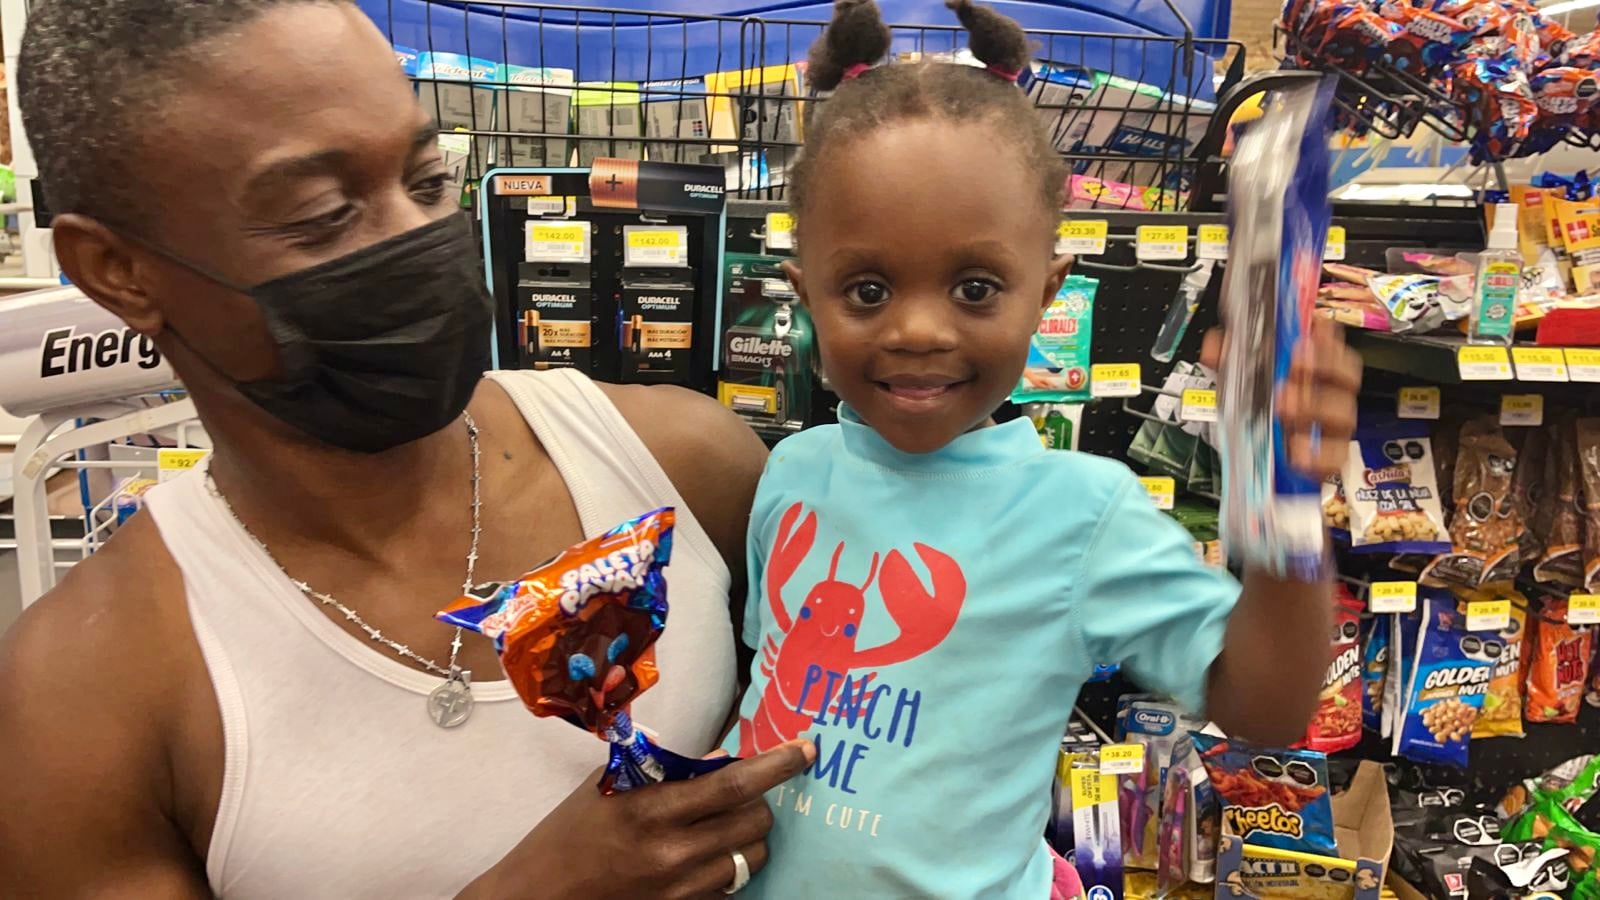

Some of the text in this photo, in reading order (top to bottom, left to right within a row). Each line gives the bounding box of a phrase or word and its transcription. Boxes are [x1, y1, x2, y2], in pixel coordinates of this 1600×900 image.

[1121, 133, 1166, 149] HALLS
[503, 180, 543, 190] NUEVA
[684, 183, 724, 194] DURACELL
[532, 293, 576, 302] DURACELL
[637, 296, 680, 305] DURACELL
[563, 348, 570, 356] 4
[664, 350, 671, 358] 4
[729, 336, 792, 357] Gillette
[740, 355, 773, 368] MACH3
[560, 539, 655, 590] PALETA
[1323, 644, 1359, 686] OLDEN
[1424, 665, 1491, 689] GOLDEN
[796, 664, 921, 748] PINCH
[802, 733, 870, 794] ME
[776, 785, 883, 838] I'M CUTE
